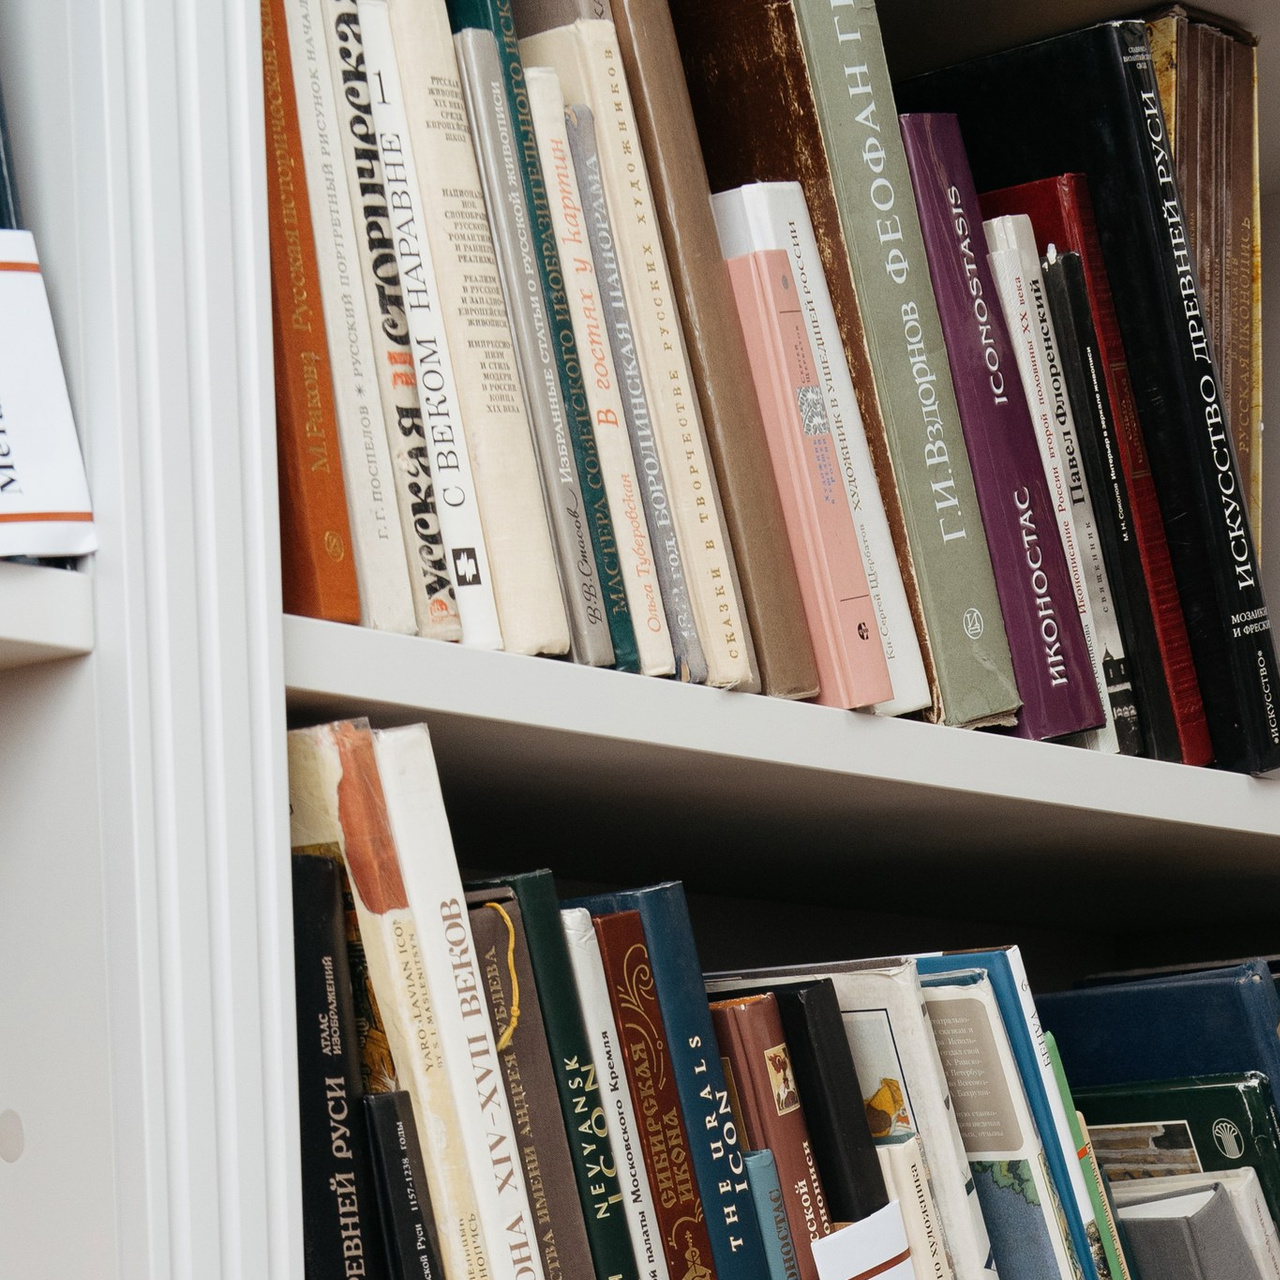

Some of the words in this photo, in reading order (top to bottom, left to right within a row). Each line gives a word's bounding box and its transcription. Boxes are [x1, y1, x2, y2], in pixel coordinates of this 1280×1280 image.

[310, 72, 332, 159] РИСУНОК
[490, 81, 517, 190] ЖИВОПИСИ
[605, 50, 648, 225] ХУДОЖНИКОВ
[1141, 90, 1173, 187] РУСИ
[380, 133, 431, 312] НАРАВНЕ
[843, 62, 910, 285] ФЕОФАН
[324, 175, 351, 288] ПОРТРЕТНЫЙ
[508, 189, 533, 276] РУССКОЙ
[585, 153, 626, 317] ПАНОРАМА
[788, 221, 814, 295] РОССИИ
[1162, 198, 1213, 365] ДРЕВНЕЙ
[341, 294, 364, 378] РУССКИЙ
[643, 244, 673, 352] РУССКИХ
[948, 184, 1009, 405] ICONOSTASIS
[1029, 278, 1070, 426] Флоренский
[364, 406, 384, 503] ПОСПЕЛОВ
[416, 336, 460, 473] ВЕКОМ
[669, 370, 710, 523] ТВОРЧЕСТВЕ
[442, 486, 466, 507] С
[834, 412, 863, 513] ХУДОЖНИК
[1058, 431, 1085, 505] Павел
[1198, 374, 1256, 592] ИСКУССТВО
[640, 583, 662, 633] Ольга
[710, 567, 740, 659] СКАЗКИ
[1014, 485, 1069, 688] ИКОНОСТАС
[322, 955, 343, 1056] ИЗОБРАЖЕНИЙ
[440, 897, 484, 1022] ВЕКОВ
[320, 1013, 334, 1056] АТЛАС
[601, 1030, 620, 1093] Кремля
[325, 1076, 353, 1159] РУСИ
[505, 1051, 535, 1138] АНДРЕЯ
[563, 1055, 611, 1221] NEVYANSK
[580, 1063, 624, 1205] ICON
[689, 1035, 725, 1161] URALS
[716, 1090, 749, 1194] ICON
[528, 1144, 552, 1226] ИМЕНИ
[616, 1098, 644, 1204] Московского
[662, 1106, 695, 1205] ИКОНА
[637, 1210, 657, 1264] палаты
[719, 1178, 744, 1254] THE
[909, 1162, 940, 1259] художника
